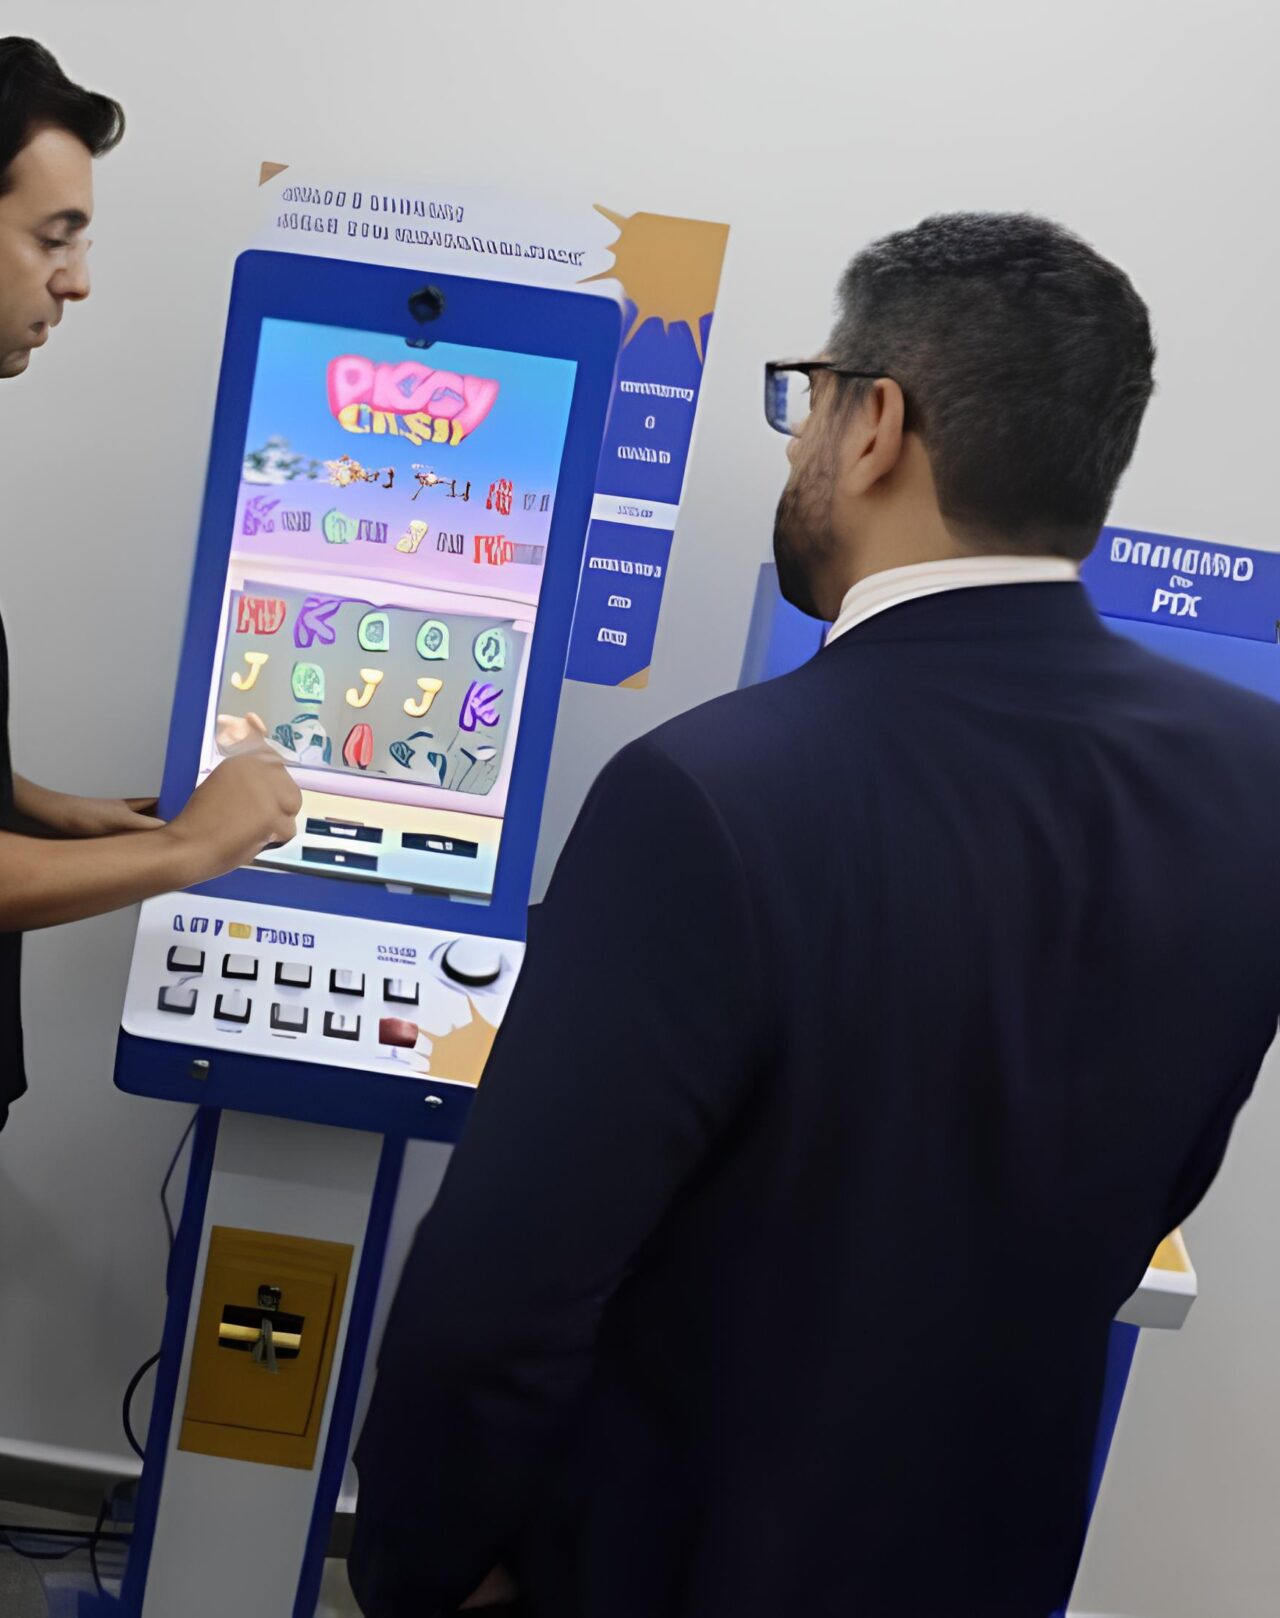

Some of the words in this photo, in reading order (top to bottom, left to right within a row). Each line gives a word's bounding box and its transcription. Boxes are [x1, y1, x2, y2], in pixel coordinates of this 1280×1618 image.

[231, 651, 269, 691] J
[345, 668, 384, 708] J
[403, 677, 443, 718] J
